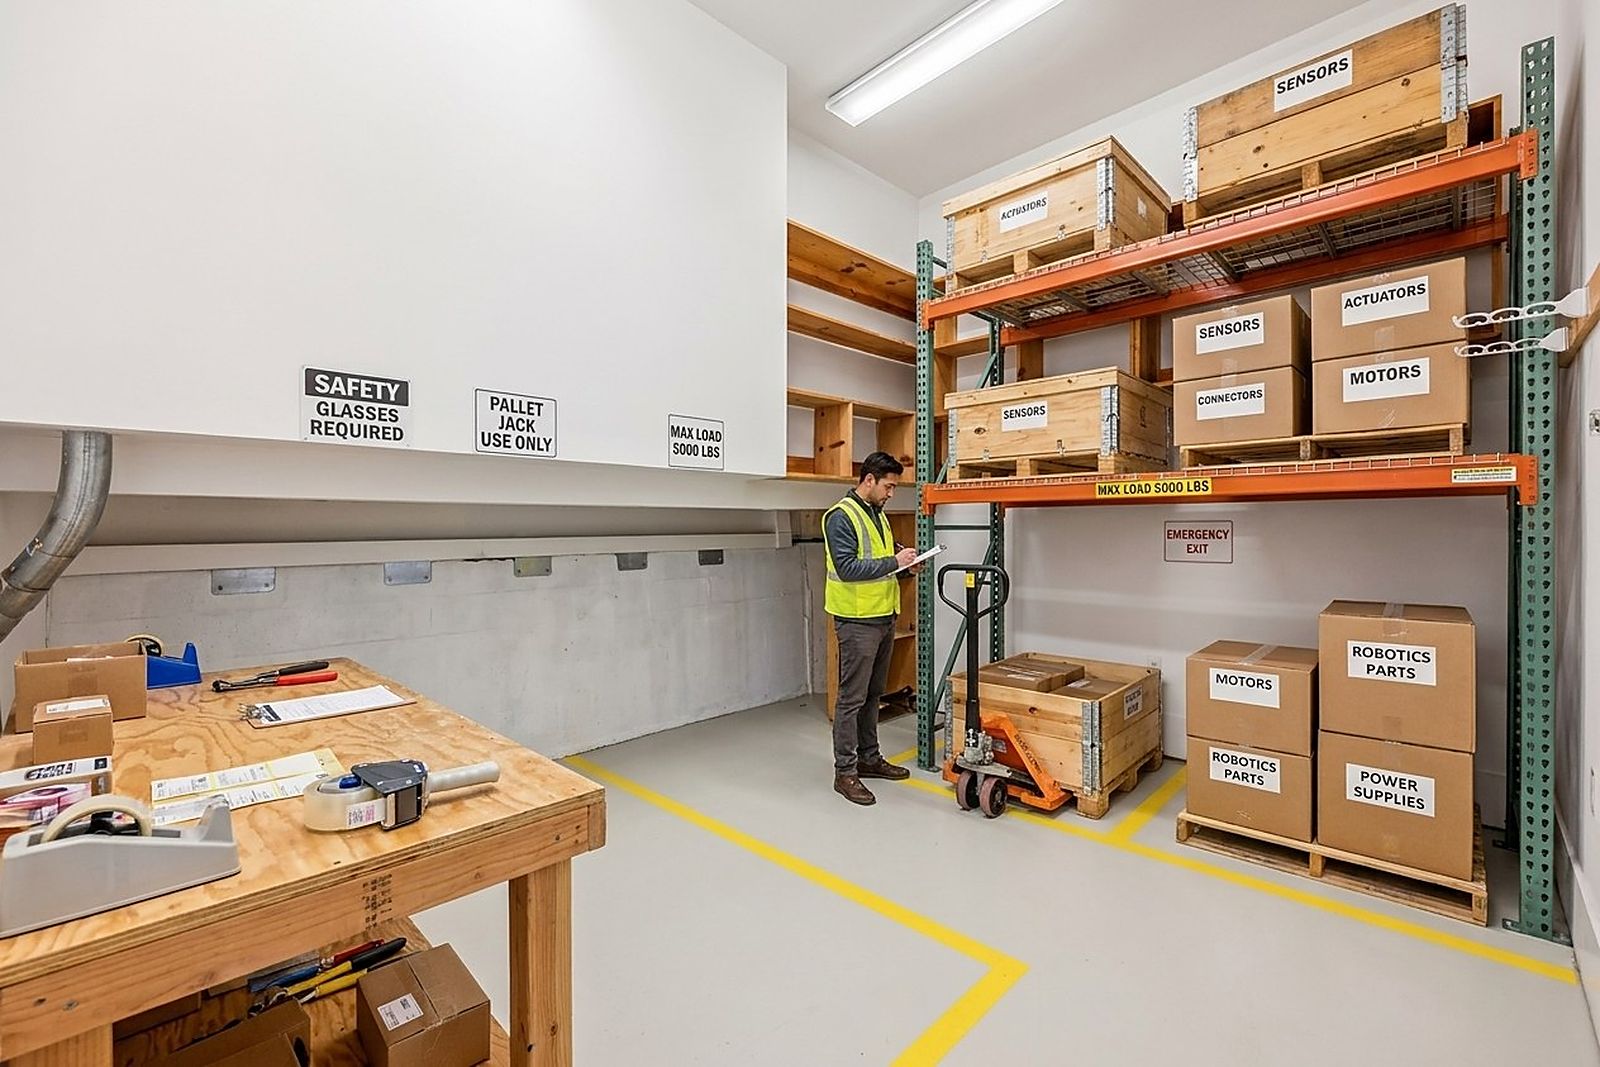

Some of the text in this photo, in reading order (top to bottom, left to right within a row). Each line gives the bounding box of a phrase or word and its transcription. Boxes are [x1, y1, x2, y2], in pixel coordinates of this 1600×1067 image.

[1276, 57, 1349, 95] SENSORS
[1344, 282, 1428, 310] ACTUATORS
[1199, 318, 1261, 339] SENSORS
[1350, 363, 1422, 386] MOTORS
[313, 374, 401, 402] SAFETY
[1197, 388, 1263, 406] CONNECTORS
[315, 401, 400, 422] GLASSES
[490, 395, 544, 417] PALLET
[1003, 405, 1046, 420] SENSORS
[310, 420, 404, 441] REQUIRED
[498, 415, 536, 434] JACK
[670, 424, 722, 442] MAX LOAD
[480, 431, 553, 453] USE ONLY
[701, 445, 720, 458] LBS
[1123, 483, 1152, 495] LOAD
[1186, 479, 1210, 493] LBS
[1166, 529, 1230, 540] EMERGENCY
[1186, 543, 1209, 554] EXIT
[1352, 646, 1432, 664] ROBOTICS
[1365, 663, 1416, 680] PARTS
[1215, 673, 1273, 691] MOTORS
[1212, 751, 1278, 773] ROBOTICS
[1224, 768, 1265, 786] PARTS
[1360, 771, 1418, 793] POWER
[1353, 786, 1425, 810] SUPPLIES
